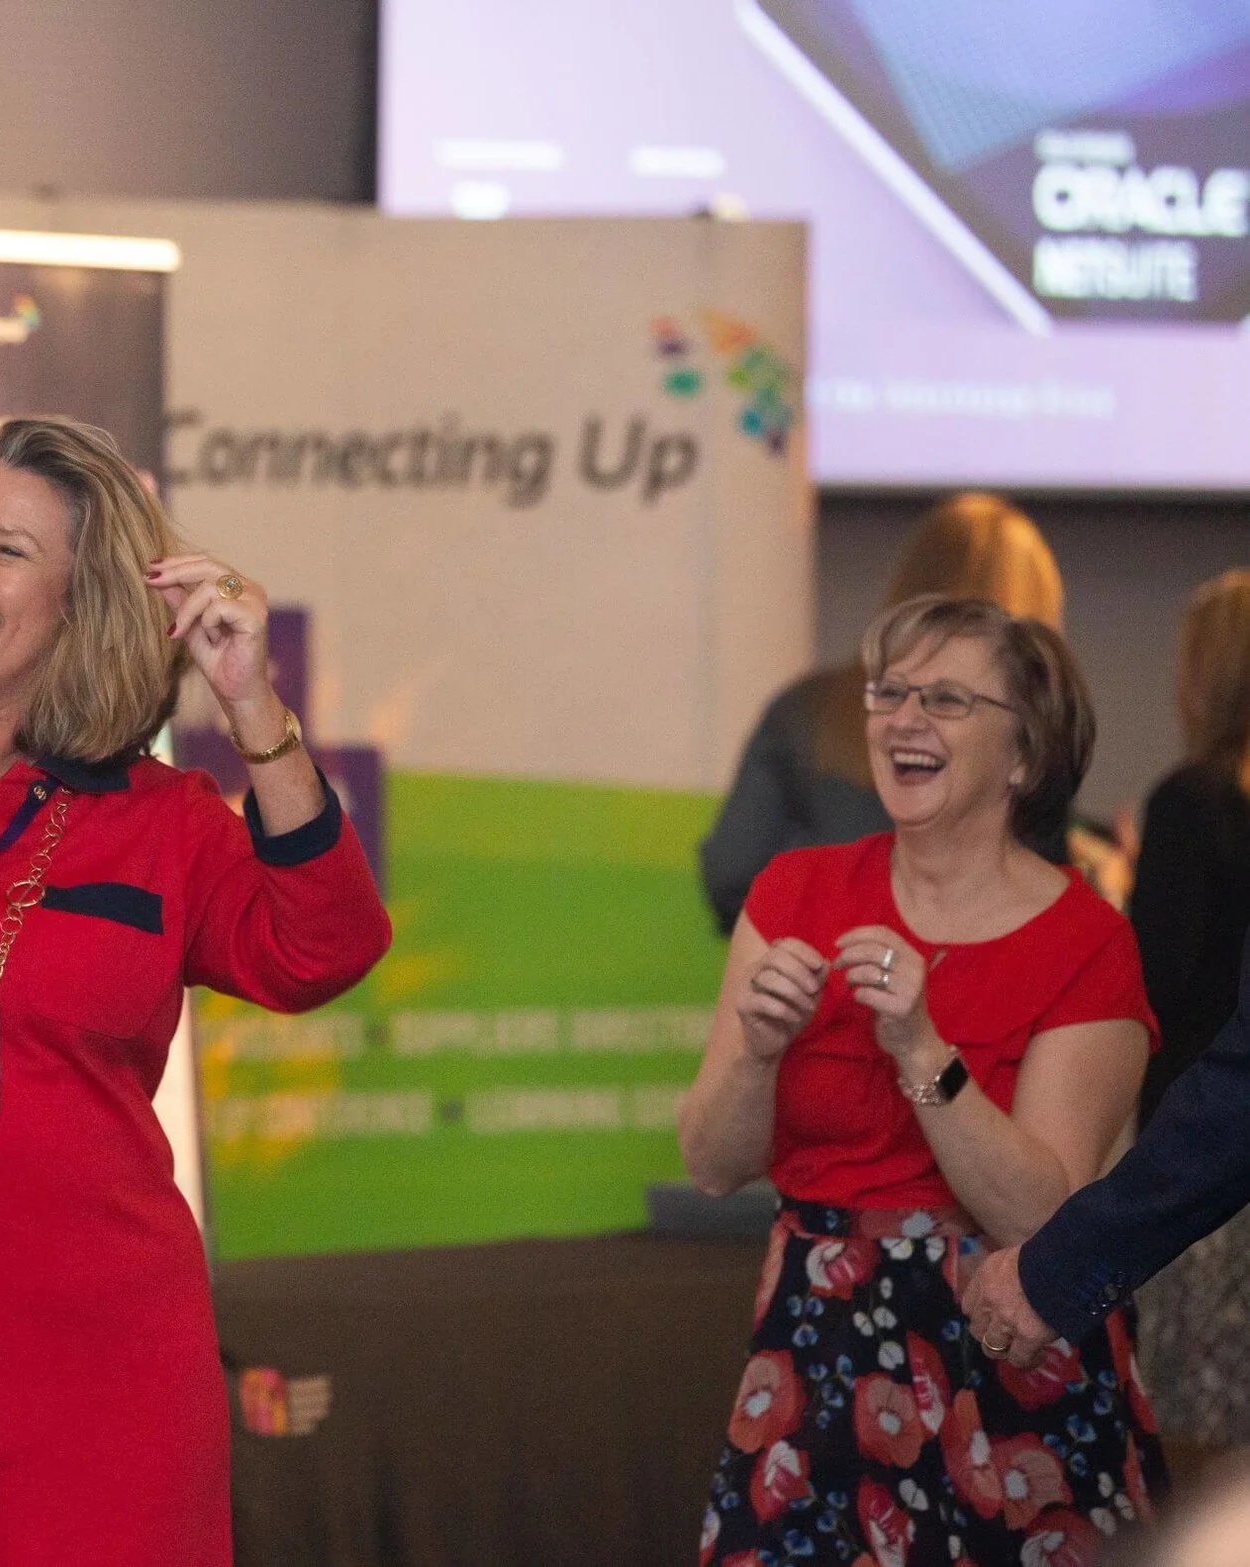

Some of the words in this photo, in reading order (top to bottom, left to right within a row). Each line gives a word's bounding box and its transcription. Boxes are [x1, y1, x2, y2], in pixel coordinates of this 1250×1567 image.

[1033, 166, 1249, 237] ORACLE
[1034, 238, 1197, 301] NETSUITE
[579, 411, 698, 506] Up
